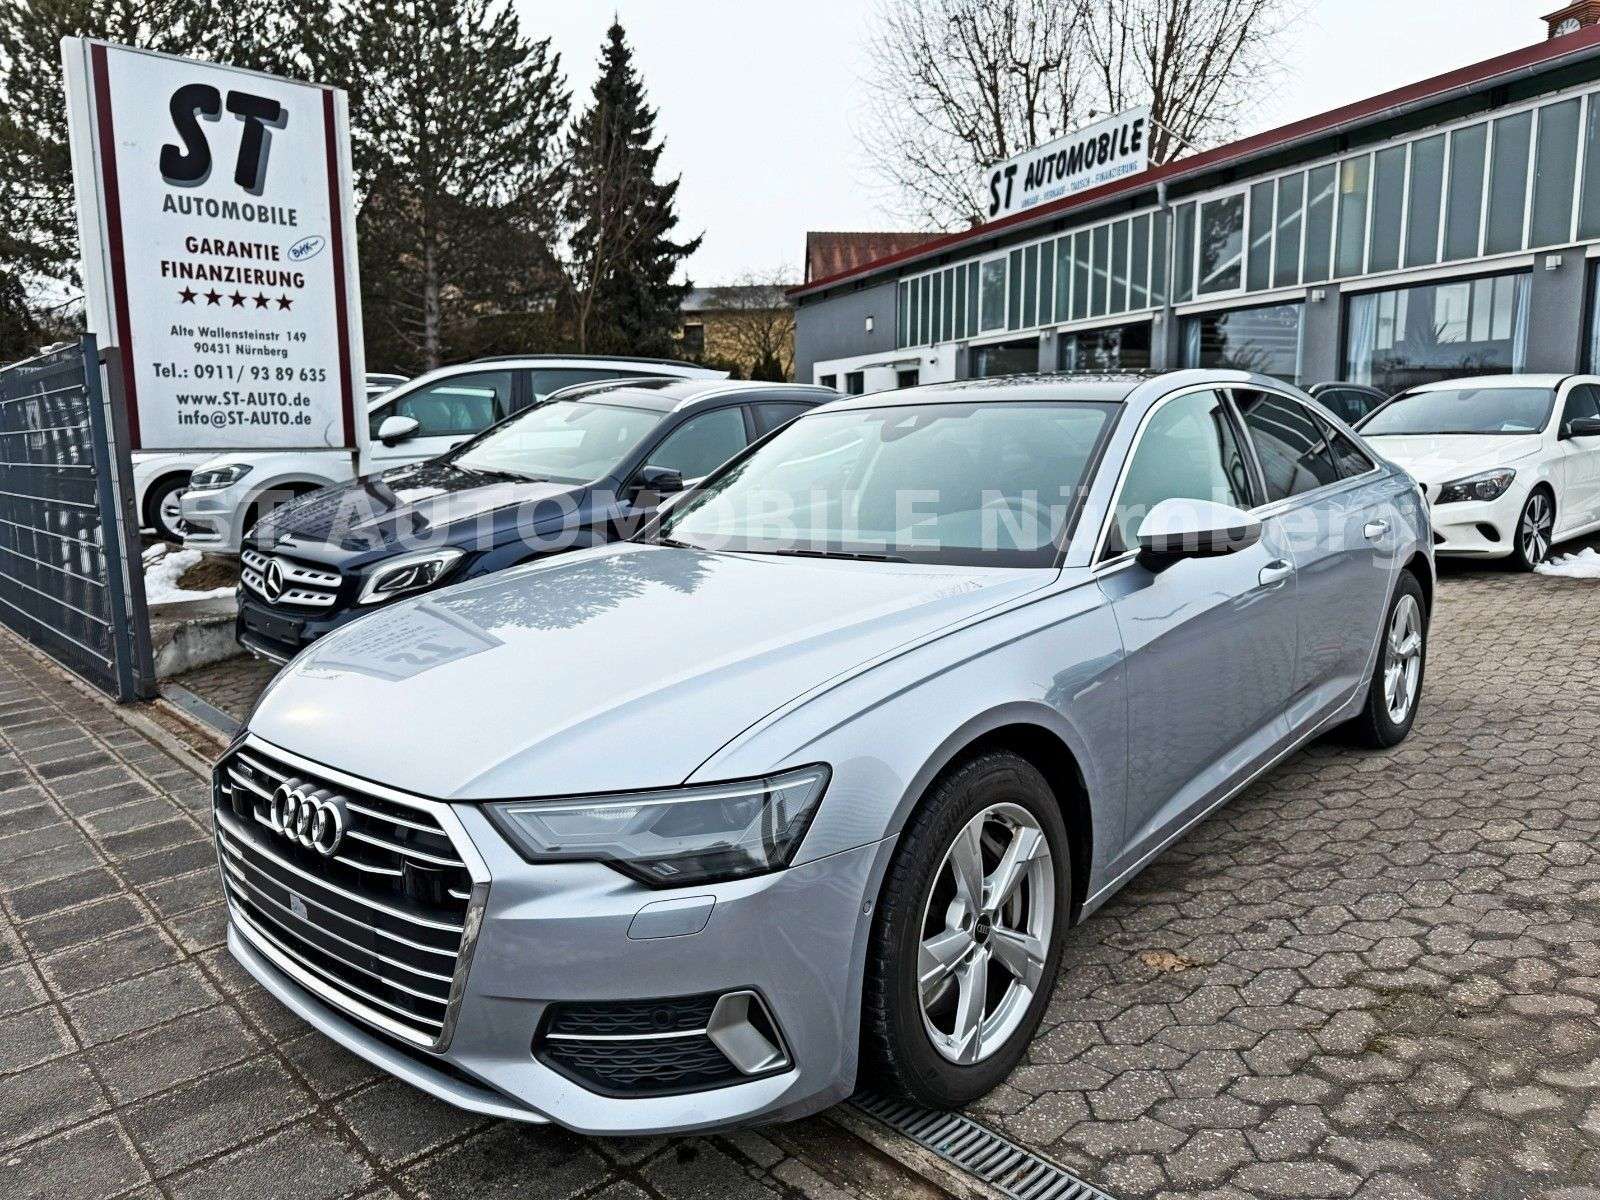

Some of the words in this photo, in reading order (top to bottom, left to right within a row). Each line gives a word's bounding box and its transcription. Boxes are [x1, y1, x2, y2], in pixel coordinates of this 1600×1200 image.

[159, 83, 289, 196] ST
[989, 163, 1018, 218] ST
[1024, 118, 1145, 192] AUTOMOBILE
[162, 193, 298, 227] AUTOMOBILE
[185, 236, 280, 261] GARANTIE
[160, 260, 305, 289] FINANZIERUNG
[170, 325, 194, 337] Alte
[199, 326, 280, 342] Wallensteinstr
[287, 331, 307, 343] 149
[194, 342, 230, 354] 90431
[235, 342, 288, 359] Nürnberg
[153, 363, 188, 379] Tel.:
[250, 366, 270, 381] 93
[275, 366, 294, 381] 89
[299, 367, 327, 383] 635
[176, 391, 311, 407] www.ST-AUTO.de
[178, 410, 312, 429] info@ST-AUTO.de
